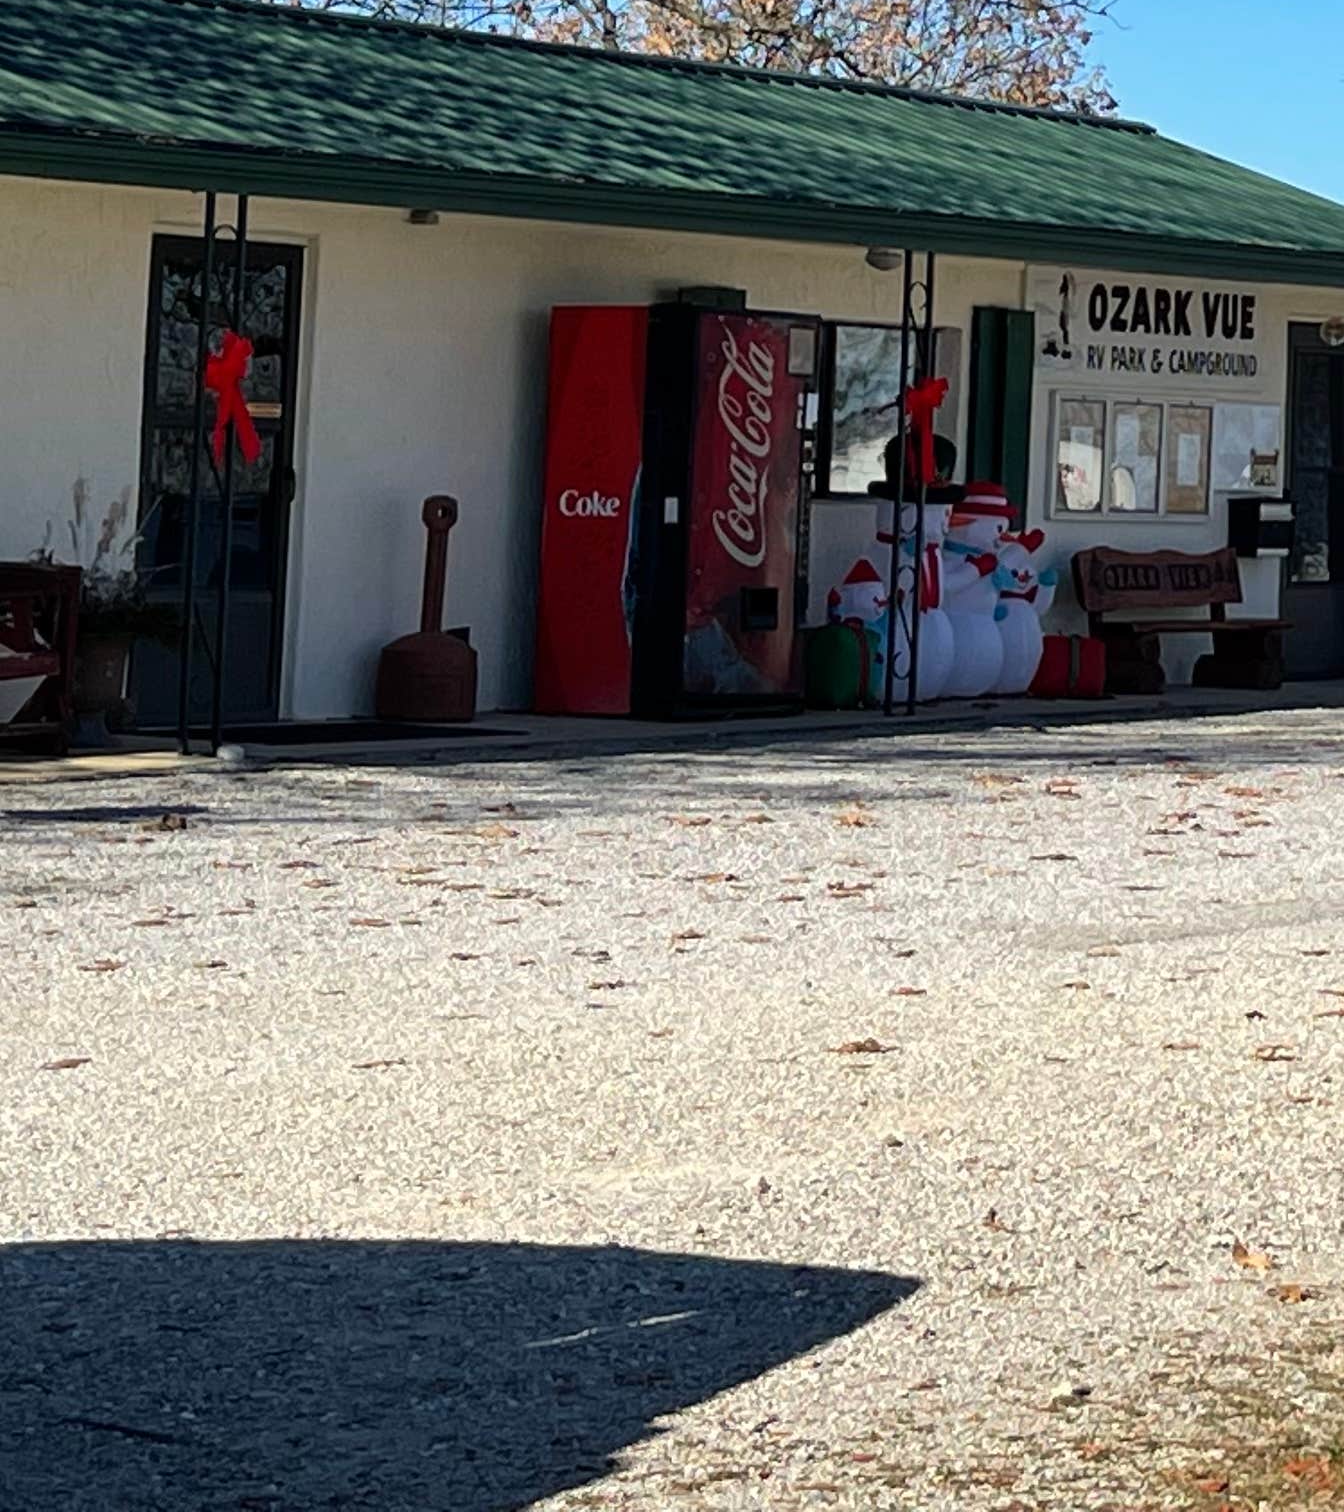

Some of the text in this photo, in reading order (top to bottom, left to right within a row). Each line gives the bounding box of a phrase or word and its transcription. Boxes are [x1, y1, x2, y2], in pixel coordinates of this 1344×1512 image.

[1088, 284, 1256, 339] OZARK VUE
[1086, 345, 1257, 376] RV PARK & CAMPGROUND
[559, 489, 620, 517] Coke
